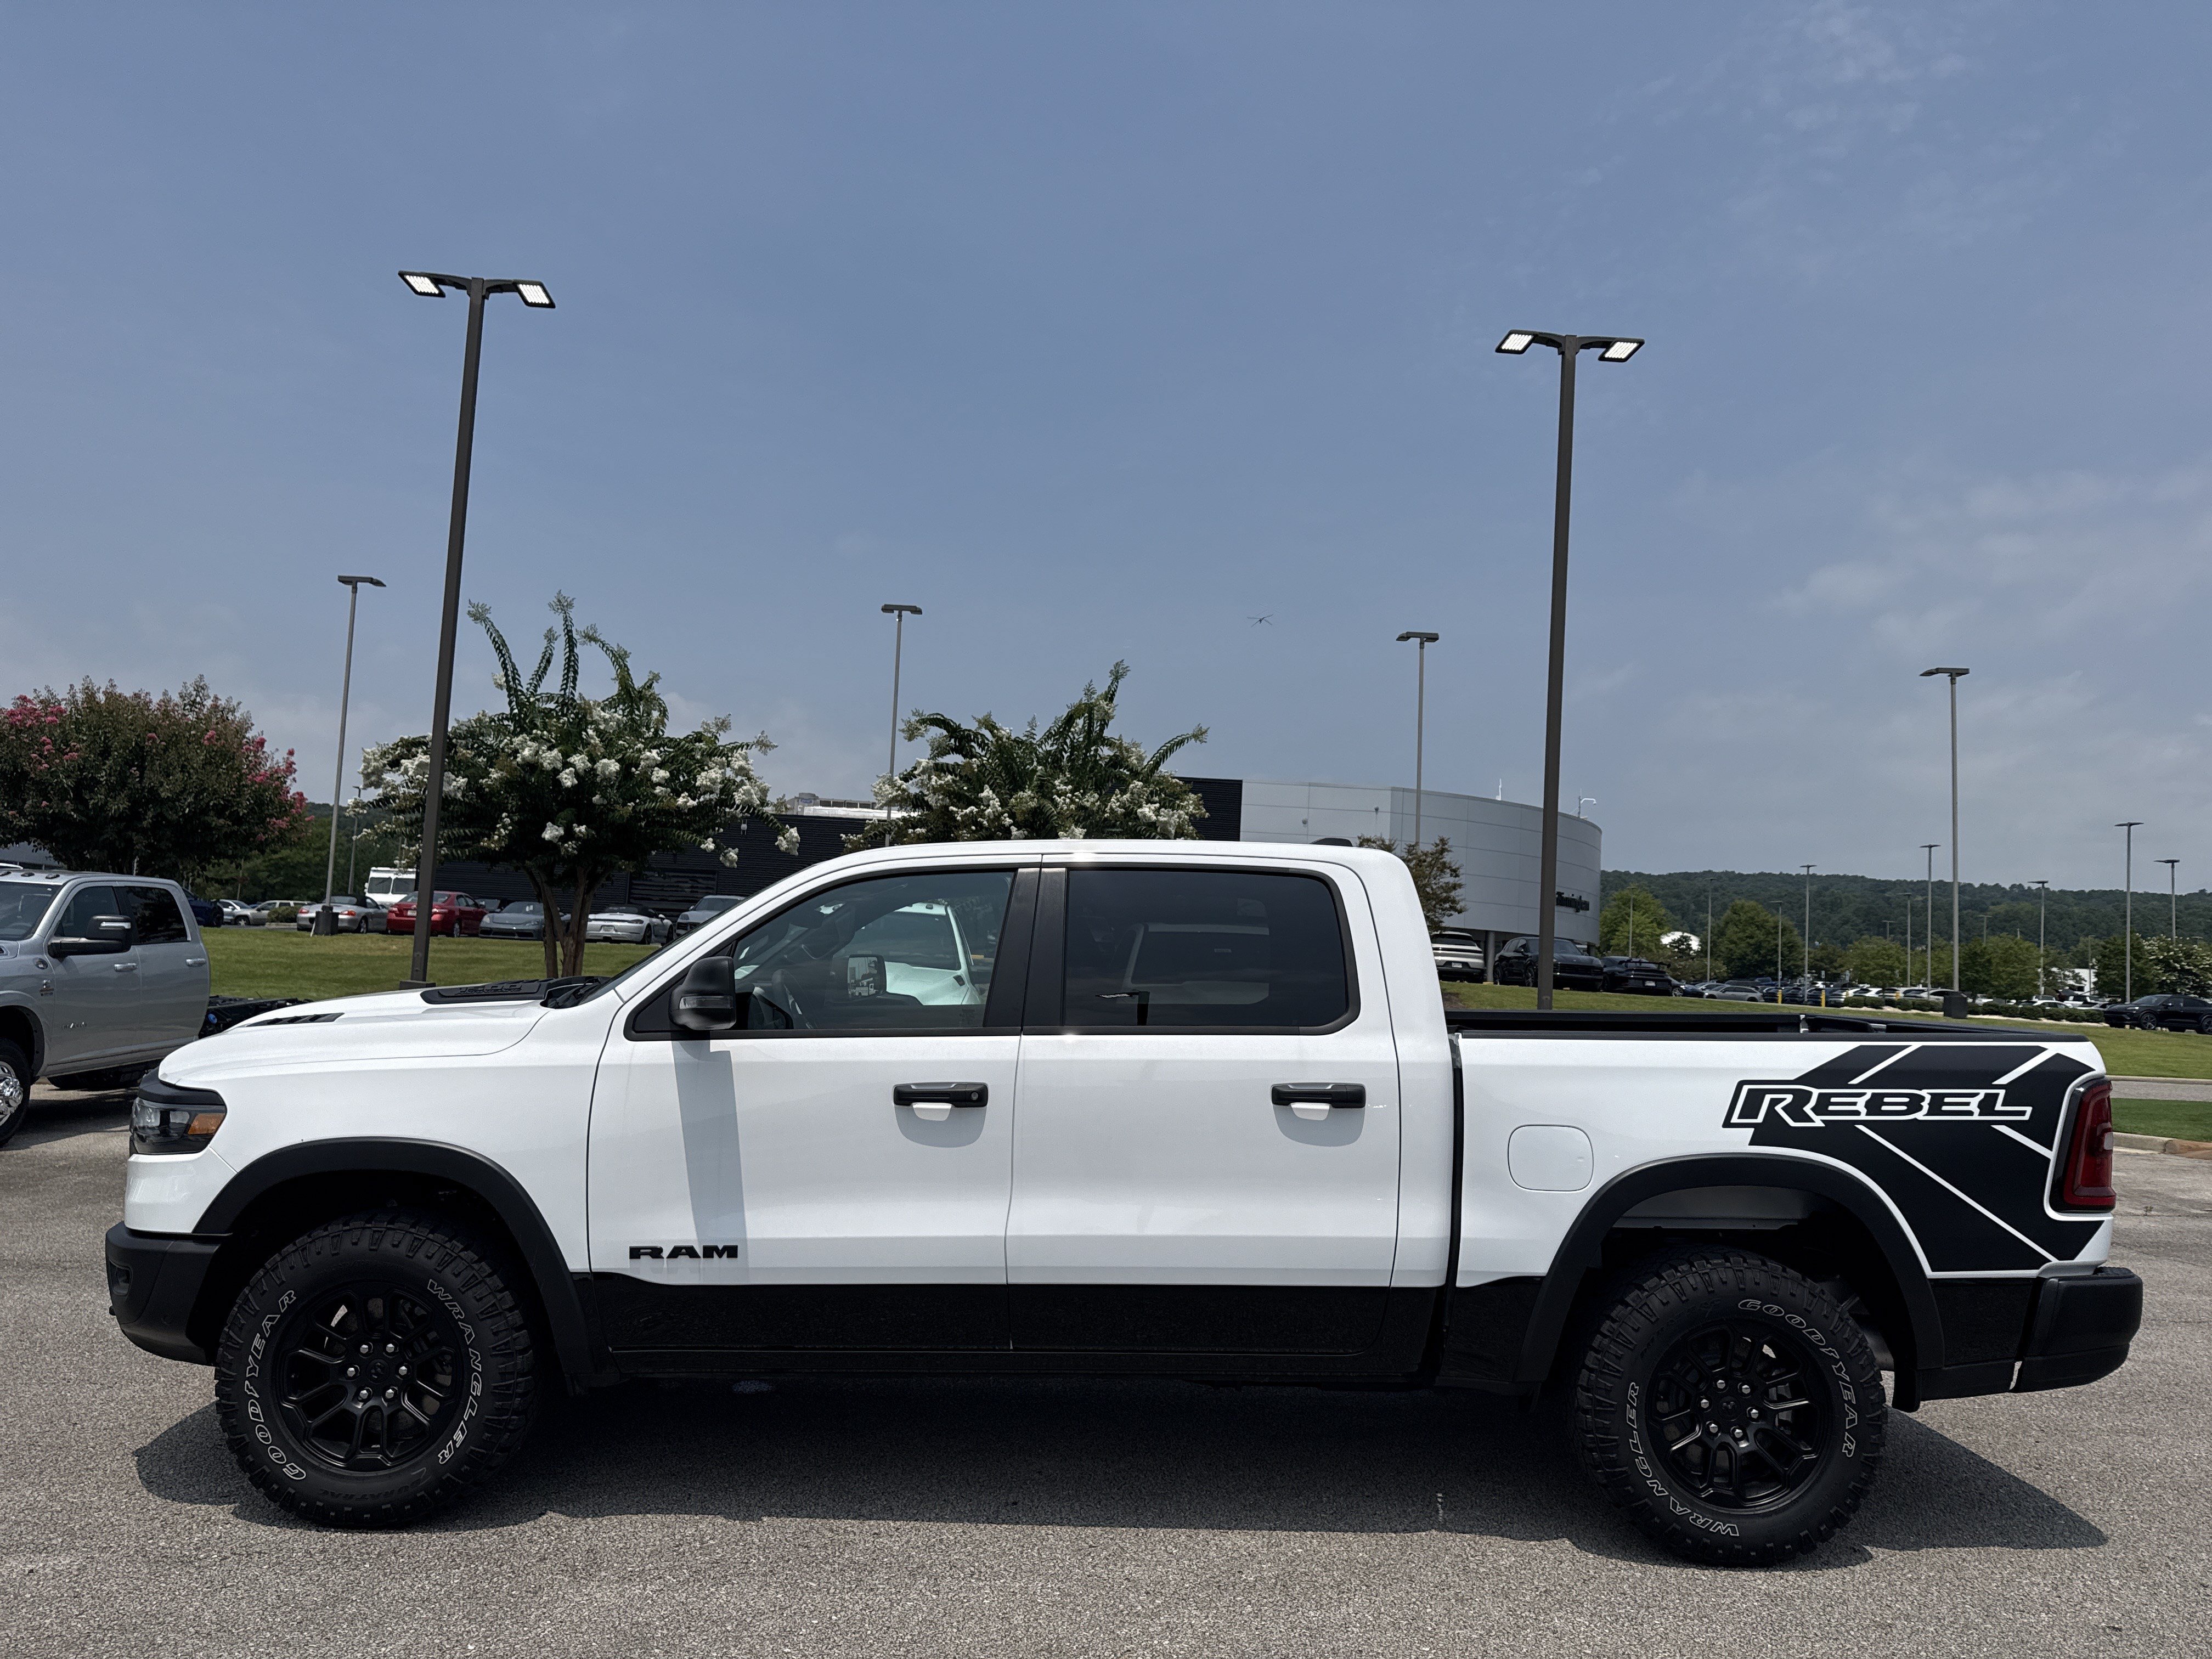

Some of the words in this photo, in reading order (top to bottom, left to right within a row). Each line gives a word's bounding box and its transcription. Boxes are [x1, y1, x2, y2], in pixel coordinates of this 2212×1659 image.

[1730, 1085, 2033, 1128] REBEL
[629, 1245, 738, 1260] RAM
[245, 1289, 307, 1481] GOODYEAR
[426, 1278, 483, 1465] WRANGLER
[1737, 1297, 1858, 1459] GOODYEAR
[1626, 1381, 1741, 1538] WRANGLER
